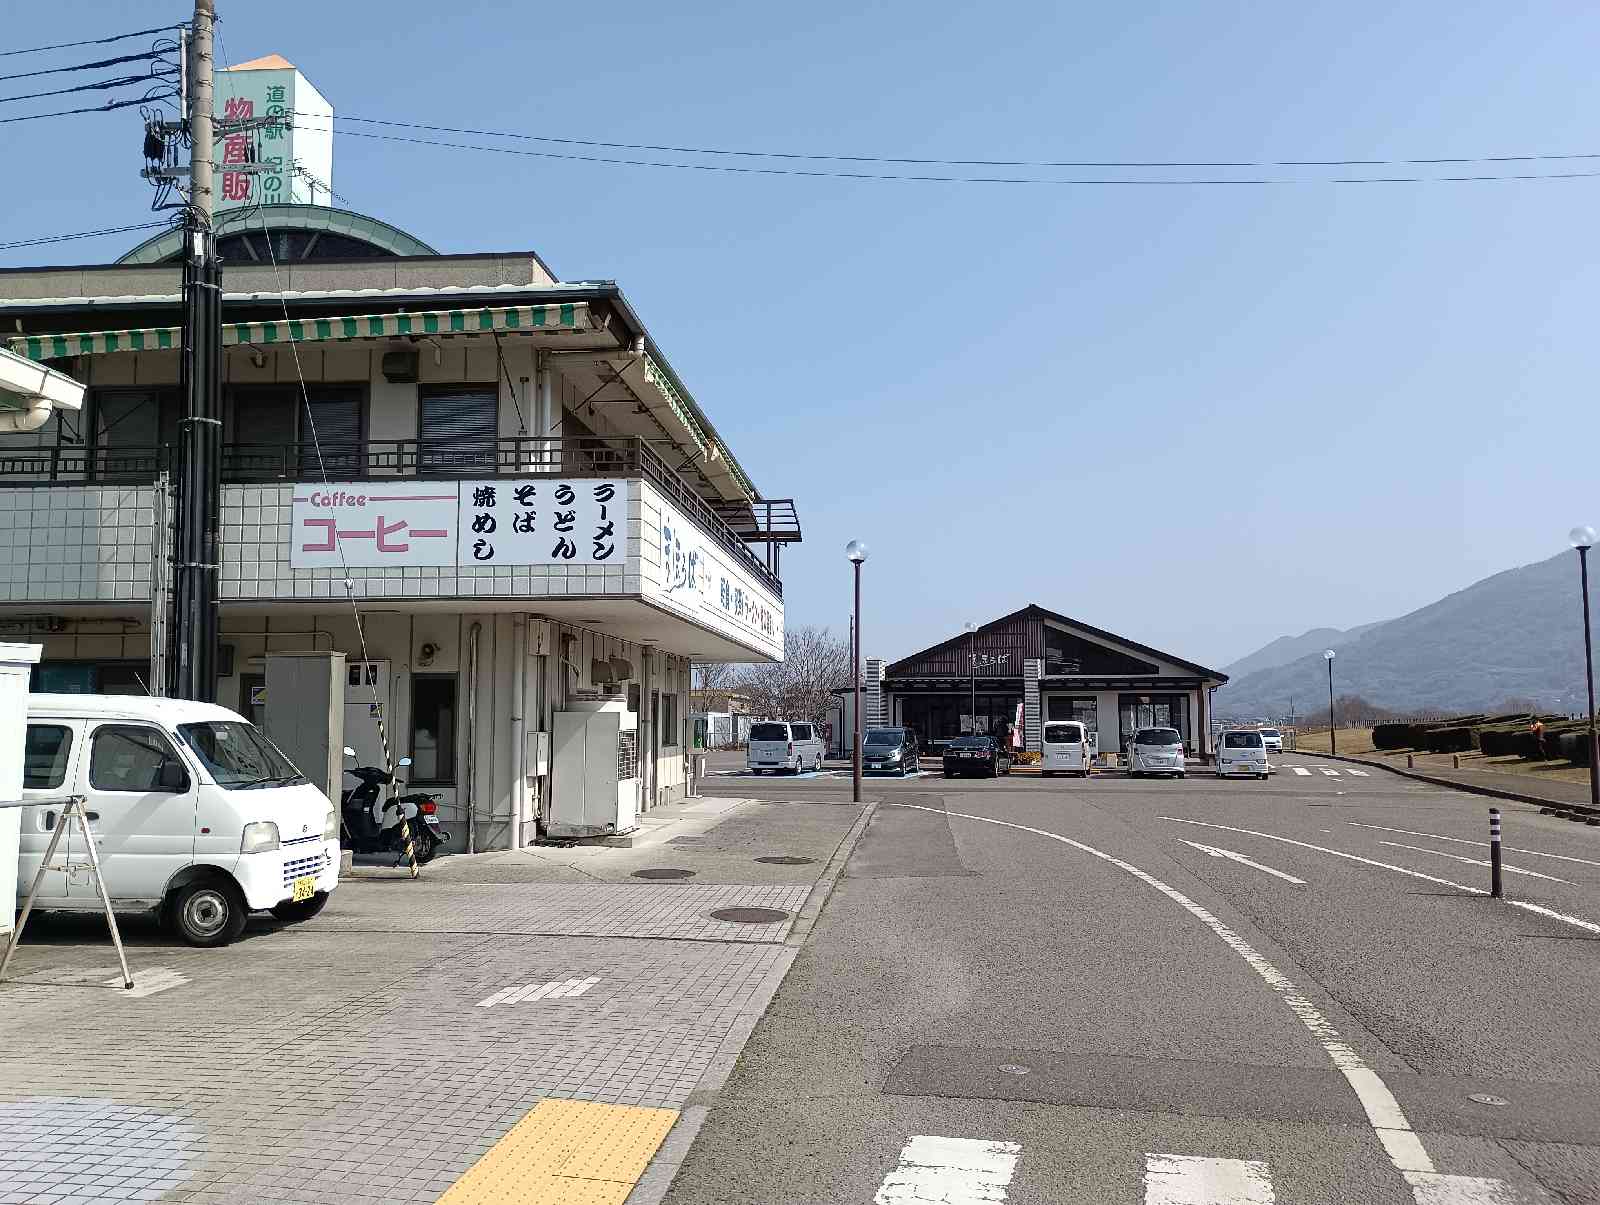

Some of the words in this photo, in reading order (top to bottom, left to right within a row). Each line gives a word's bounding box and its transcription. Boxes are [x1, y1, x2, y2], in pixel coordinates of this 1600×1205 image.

[302, 515, 447, 553] コーヒー
[471, 485, 497, 561] 焼めし
[512, 484, 537, 534] そば
[551, 483, 577, 560] うどん
[592, 482, 616, 561] ラーメン
